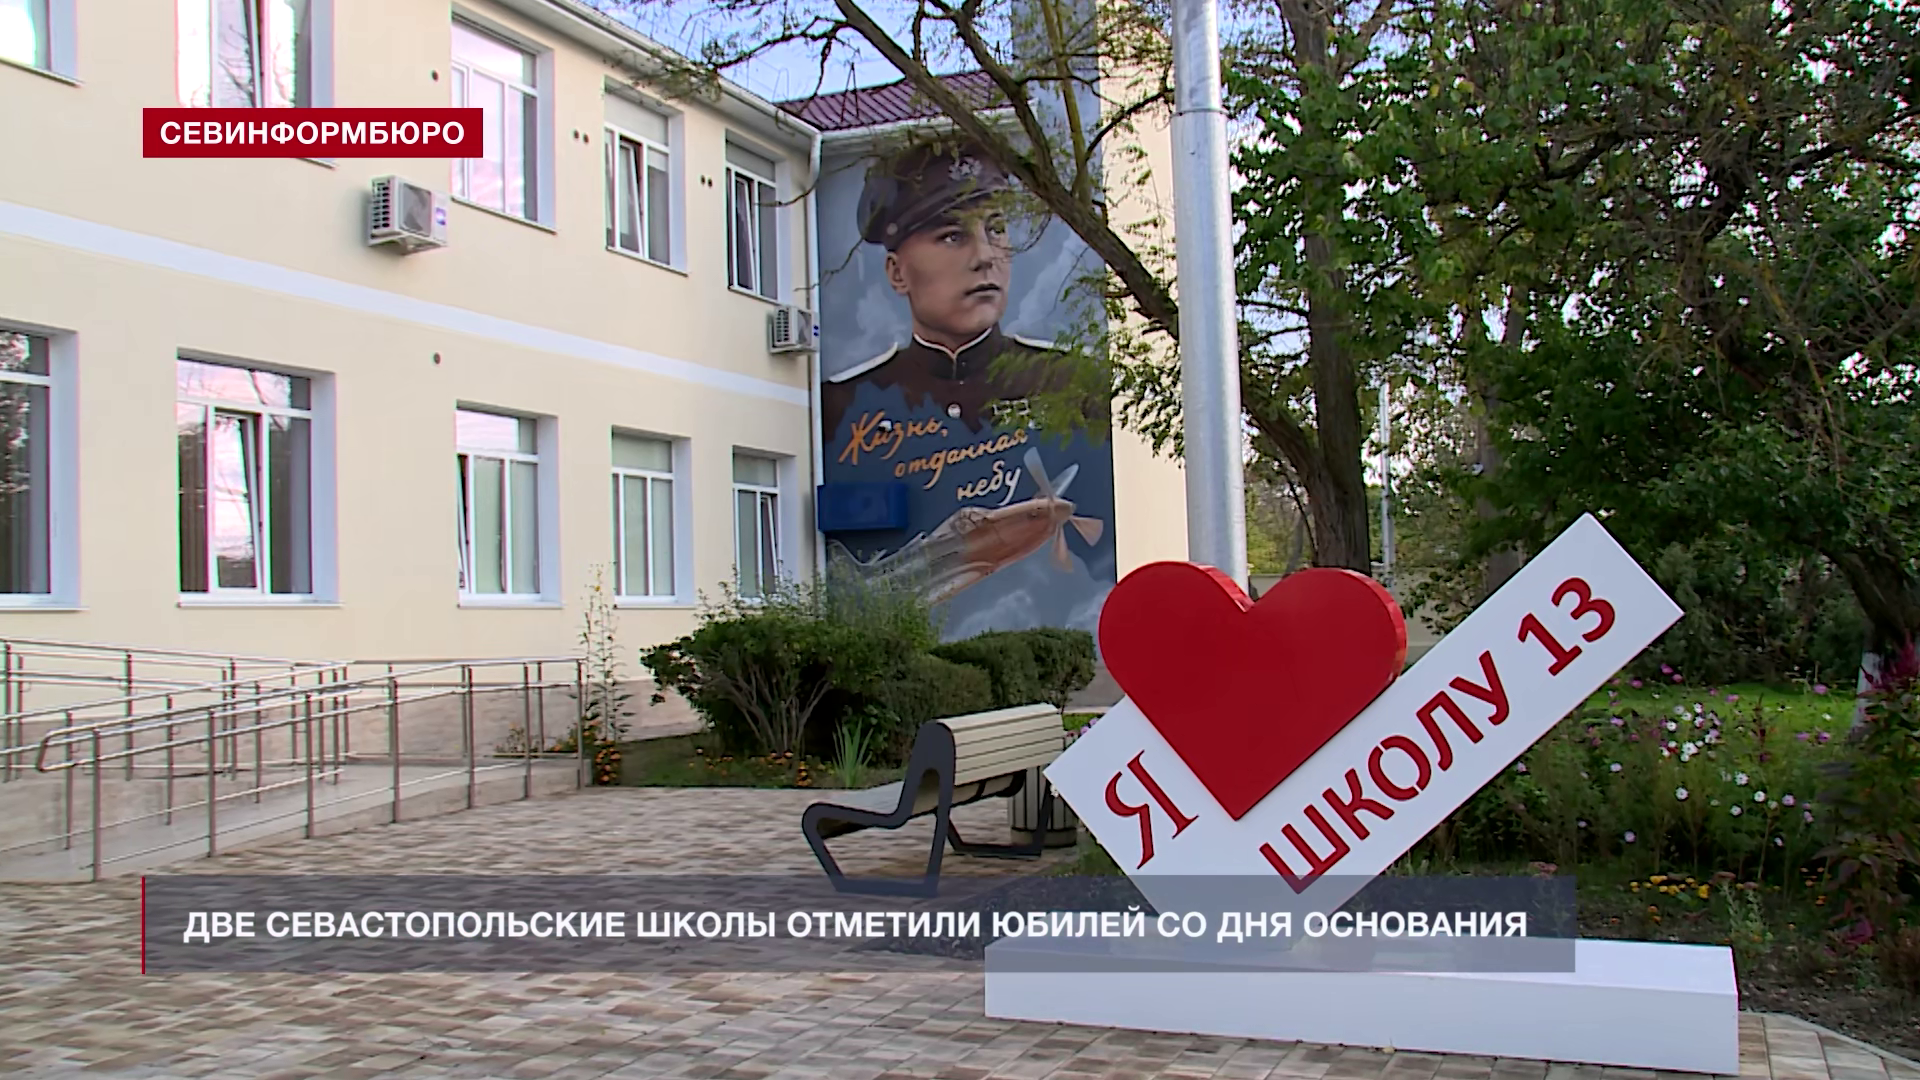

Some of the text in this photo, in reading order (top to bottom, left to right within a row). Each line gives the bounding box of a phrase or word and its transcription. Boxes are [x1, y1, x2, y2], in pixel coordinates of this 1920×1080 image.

[838, 411, 948, 466] Жизнь,
[894, 428, 1029, 490] отданная
[957, 460, 1022, 506] небу
[1258, 576, 1616, 894] ШКОЛУ 13
[1103, 750, 1199, 870] Я
